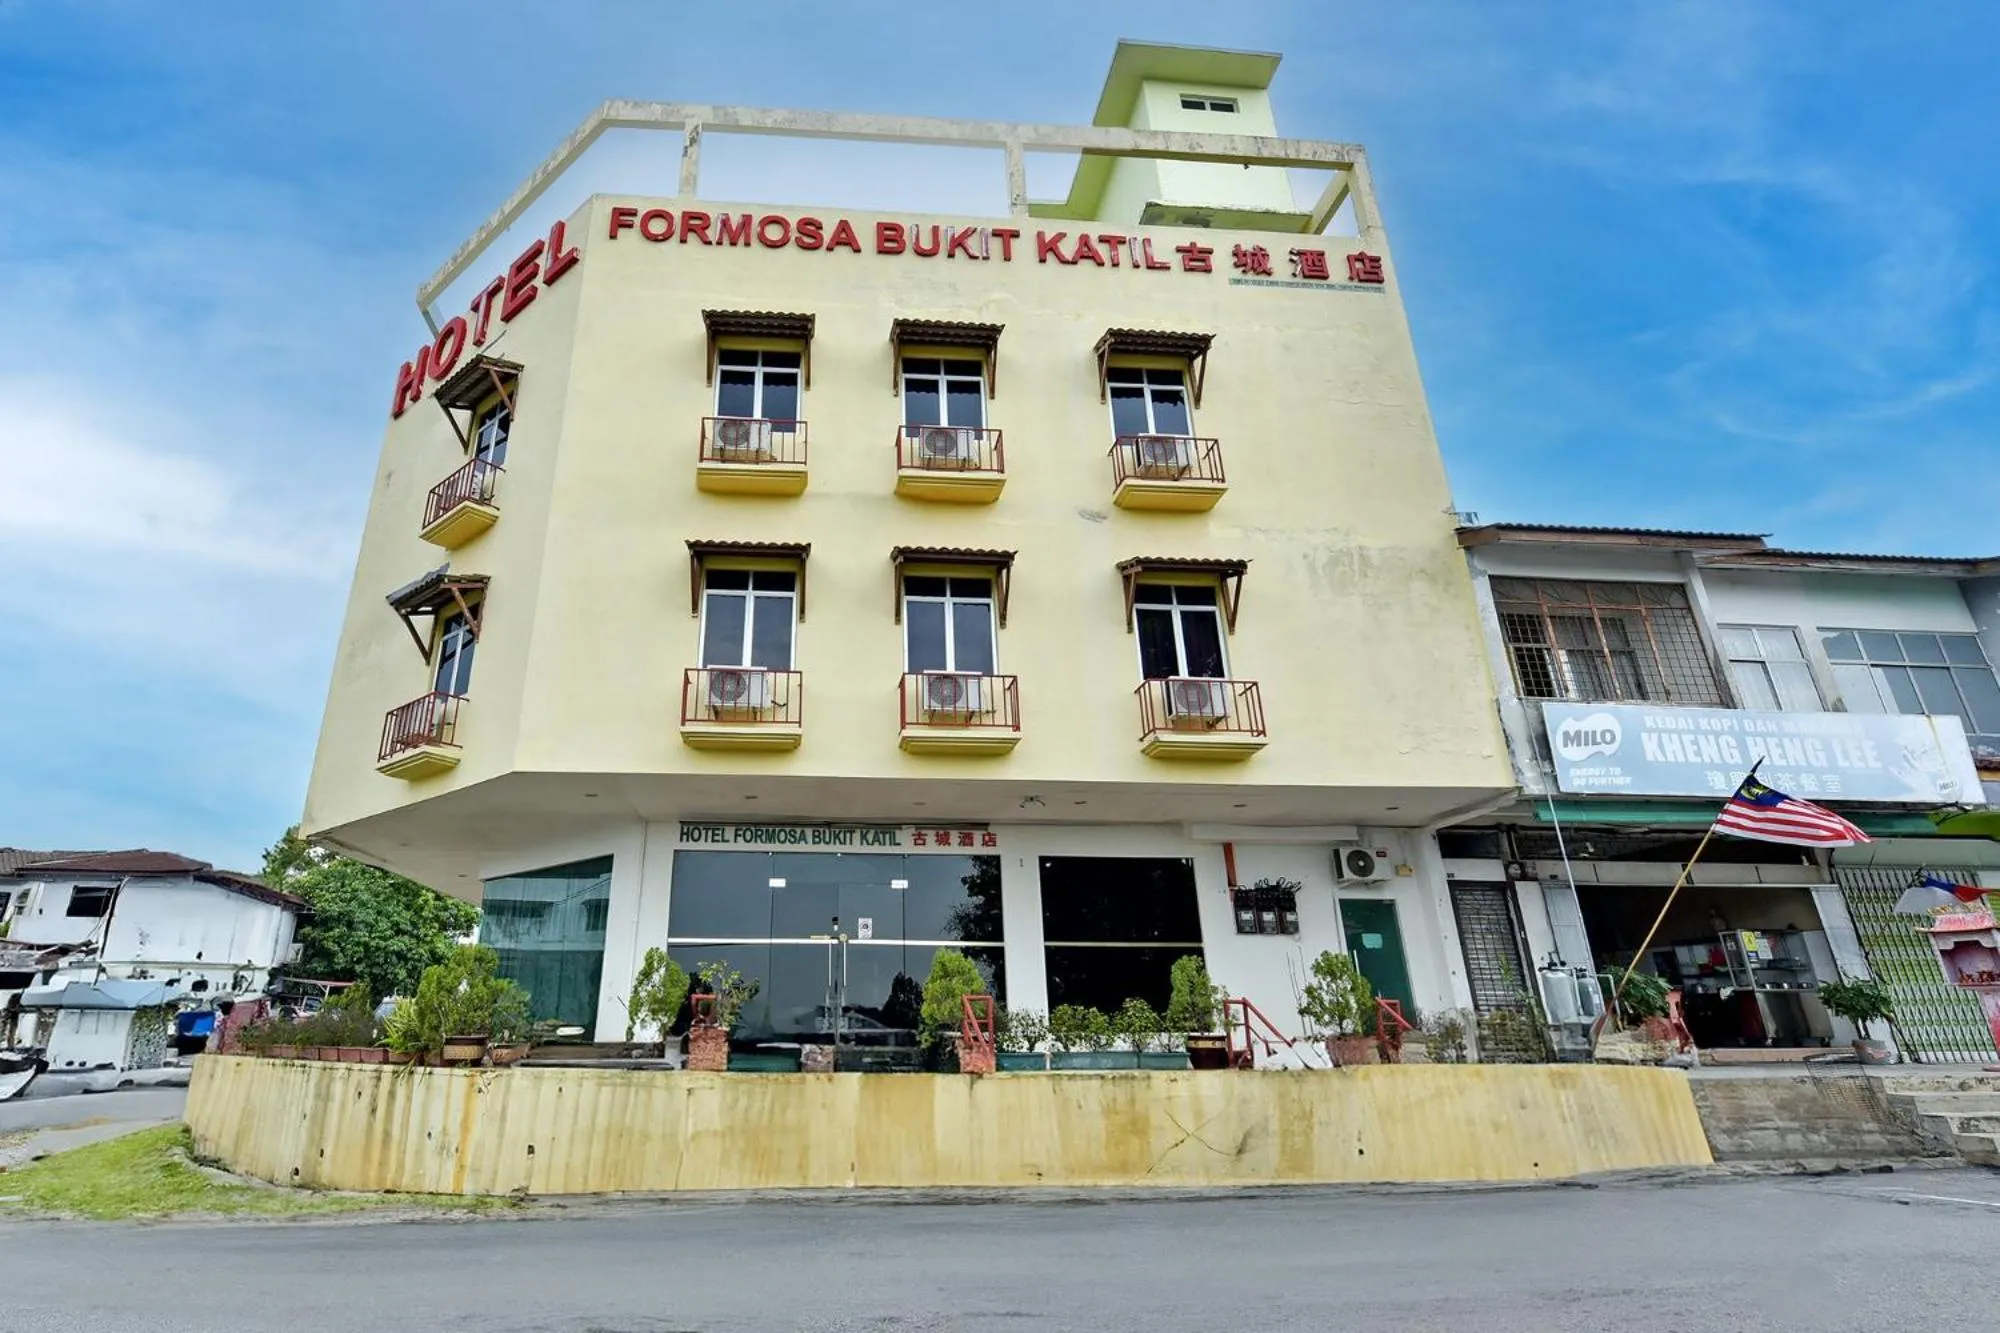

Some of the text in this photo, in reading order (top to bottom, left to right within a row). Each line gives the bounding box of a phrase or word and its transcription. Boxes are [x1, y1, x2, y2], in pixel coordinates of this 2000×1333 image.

[609, 207, 1171, 270] FORMOSA BUKIT KATIL
[1174, 240, 1385, 284] 古城酒店
[392, 220, 580, 419] HOTEL
[1562, 728, 1617, 748] MILO
[1643, 715, 1695, 730] KEDAI
[1698, 717, 1739, 732] KOPI
[1641, 732, 1883, 769] KHENG HENG LEE
[679, 825, 902, 847] HOTEL FORMOSA BUKIT KATIL
[911, 831, 998, 848] 古城酒店
